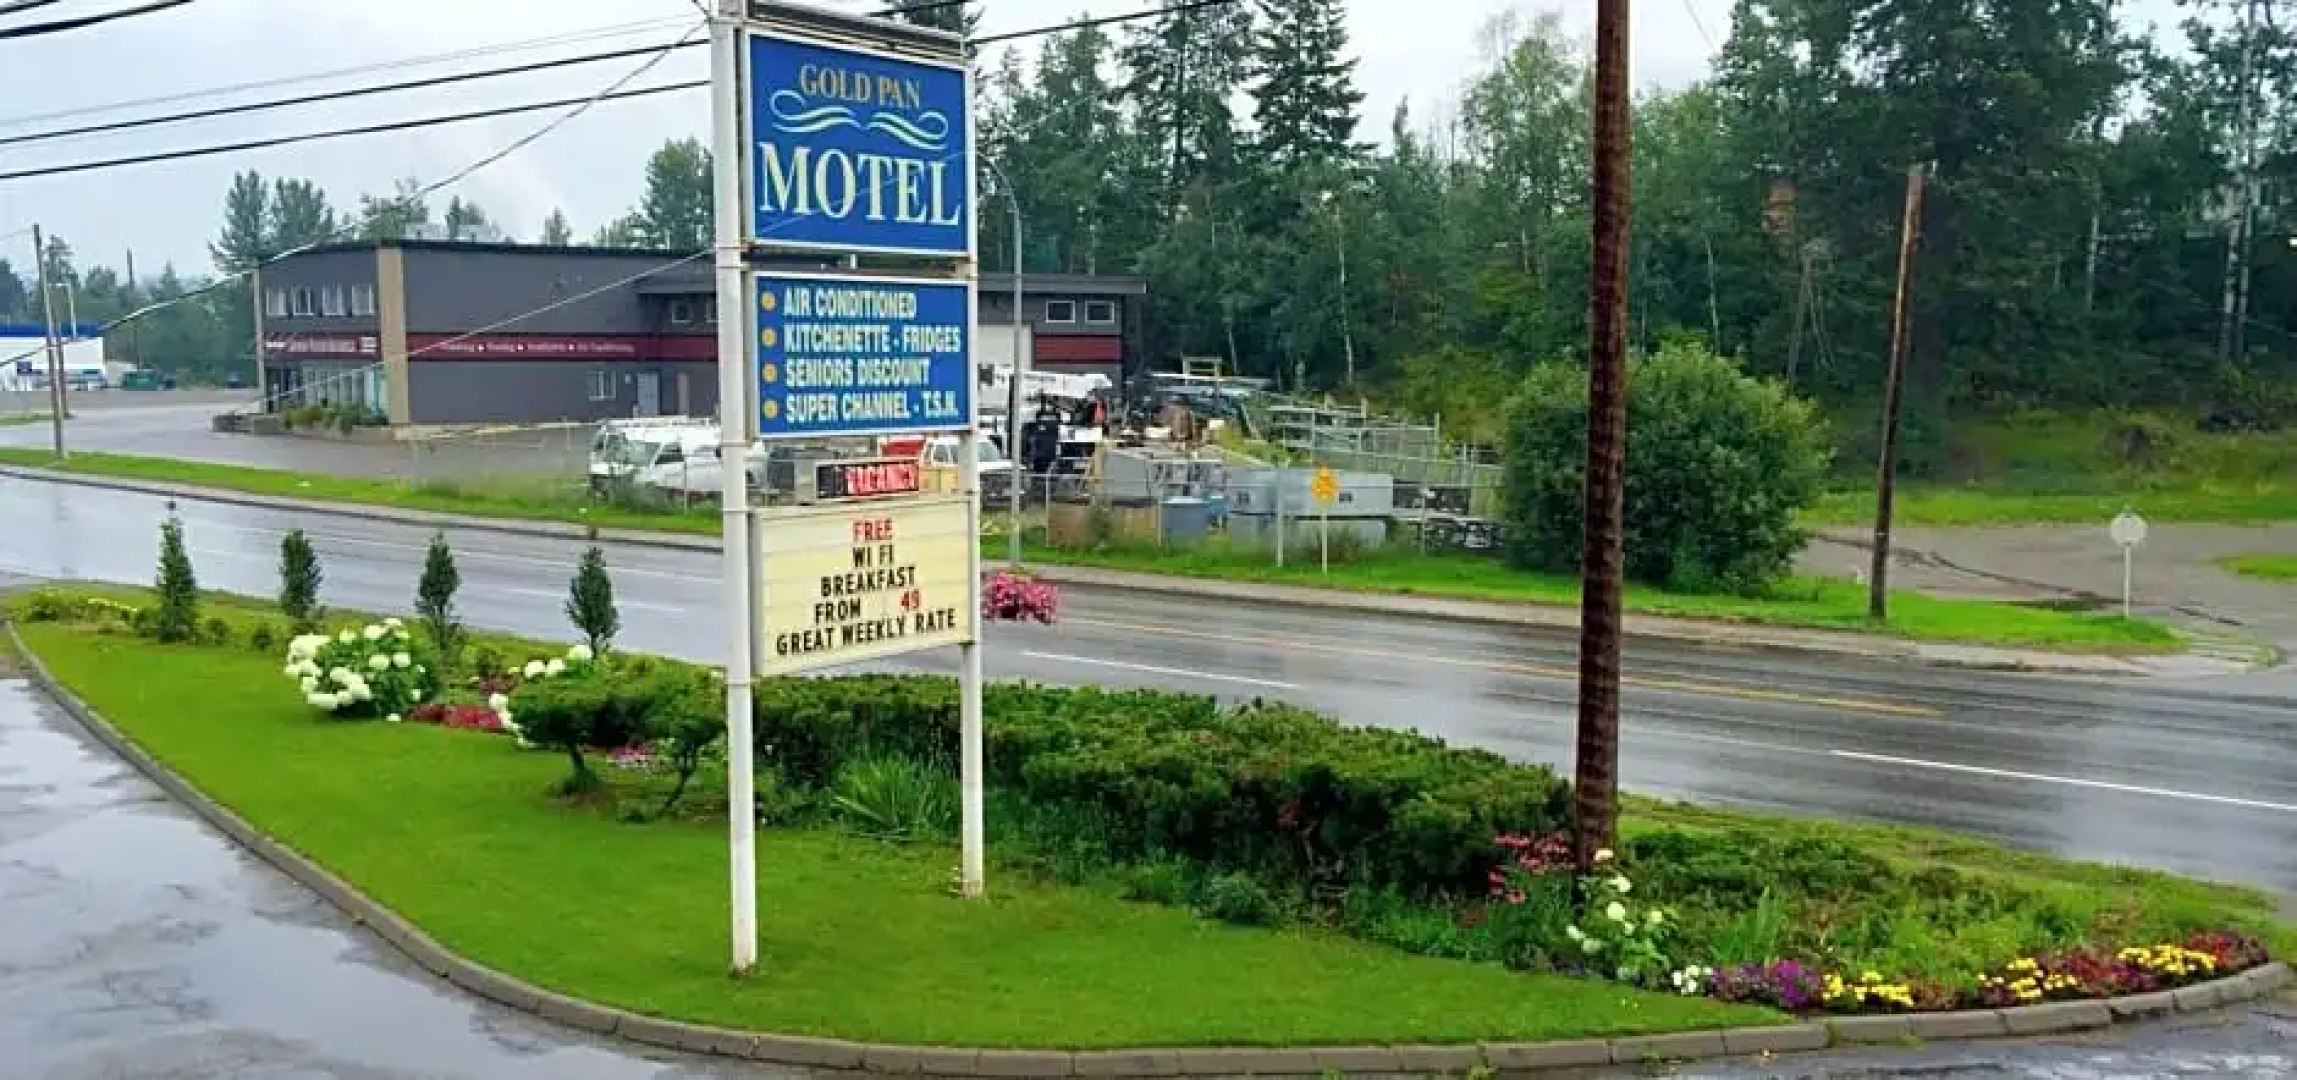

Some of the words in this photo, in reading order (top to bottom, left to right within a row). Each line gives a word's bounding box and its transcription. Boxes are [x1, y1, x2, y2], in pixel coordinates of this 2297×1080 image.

[801, 65, 871, 102] GOLD
[879, 76, 920, 108] PAN
[758, 142, 960, 225] MOTEL
[784, 287, 812, 316] AIR
[815, 288, 917, 319] CONDITIONED
[784, 324, 890, 353] KITCHENETTE
[903, 324, 961, 353] FRIDGES
[786, 358, 853, 387] SENIORS
[857, 357, 931, 387] DISCOUNT
[786, 393, 839, 423] SUPER
[842, 391, 911, 420] CHANNEL
[852, 517, 893, 542] FREE
[852, 546, 872, 567] WI
[879, 544, 895, 565] FI
[820, 566, 916, 597] BREAKFAST
[814, 598, 861, 624] FROM
[900, 589, 921, 611] 49
[776, 627, 836, 656] GREAT
[841, 615, 906, 646] WEEKLY
[915, 608, 956, 634] RATE
